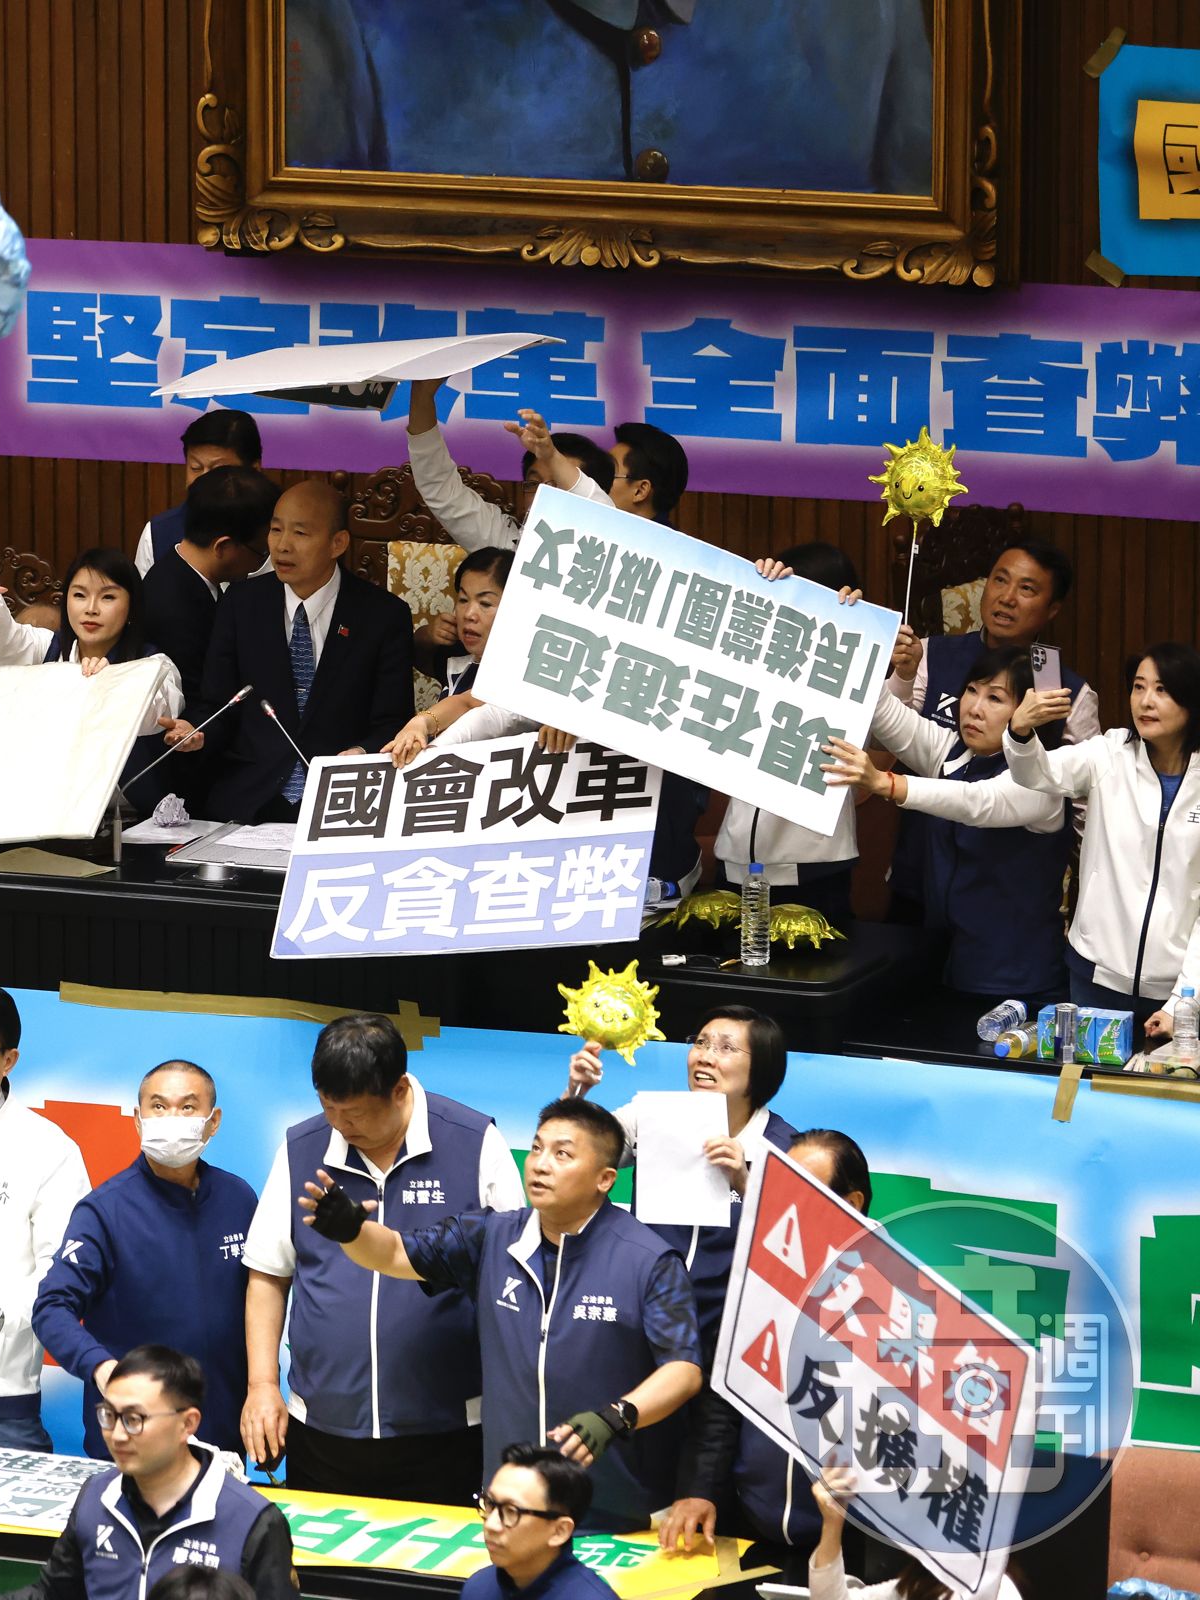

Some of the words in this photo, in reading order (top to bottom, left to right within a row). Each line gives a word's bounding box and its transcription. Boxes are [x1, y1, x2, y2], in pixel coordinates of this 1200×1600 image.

[523, 613, 848, 796] 現在通過
[306, 738, 653, 842] 國會改革
[284, 842, 648, 946] 反貪查弊
